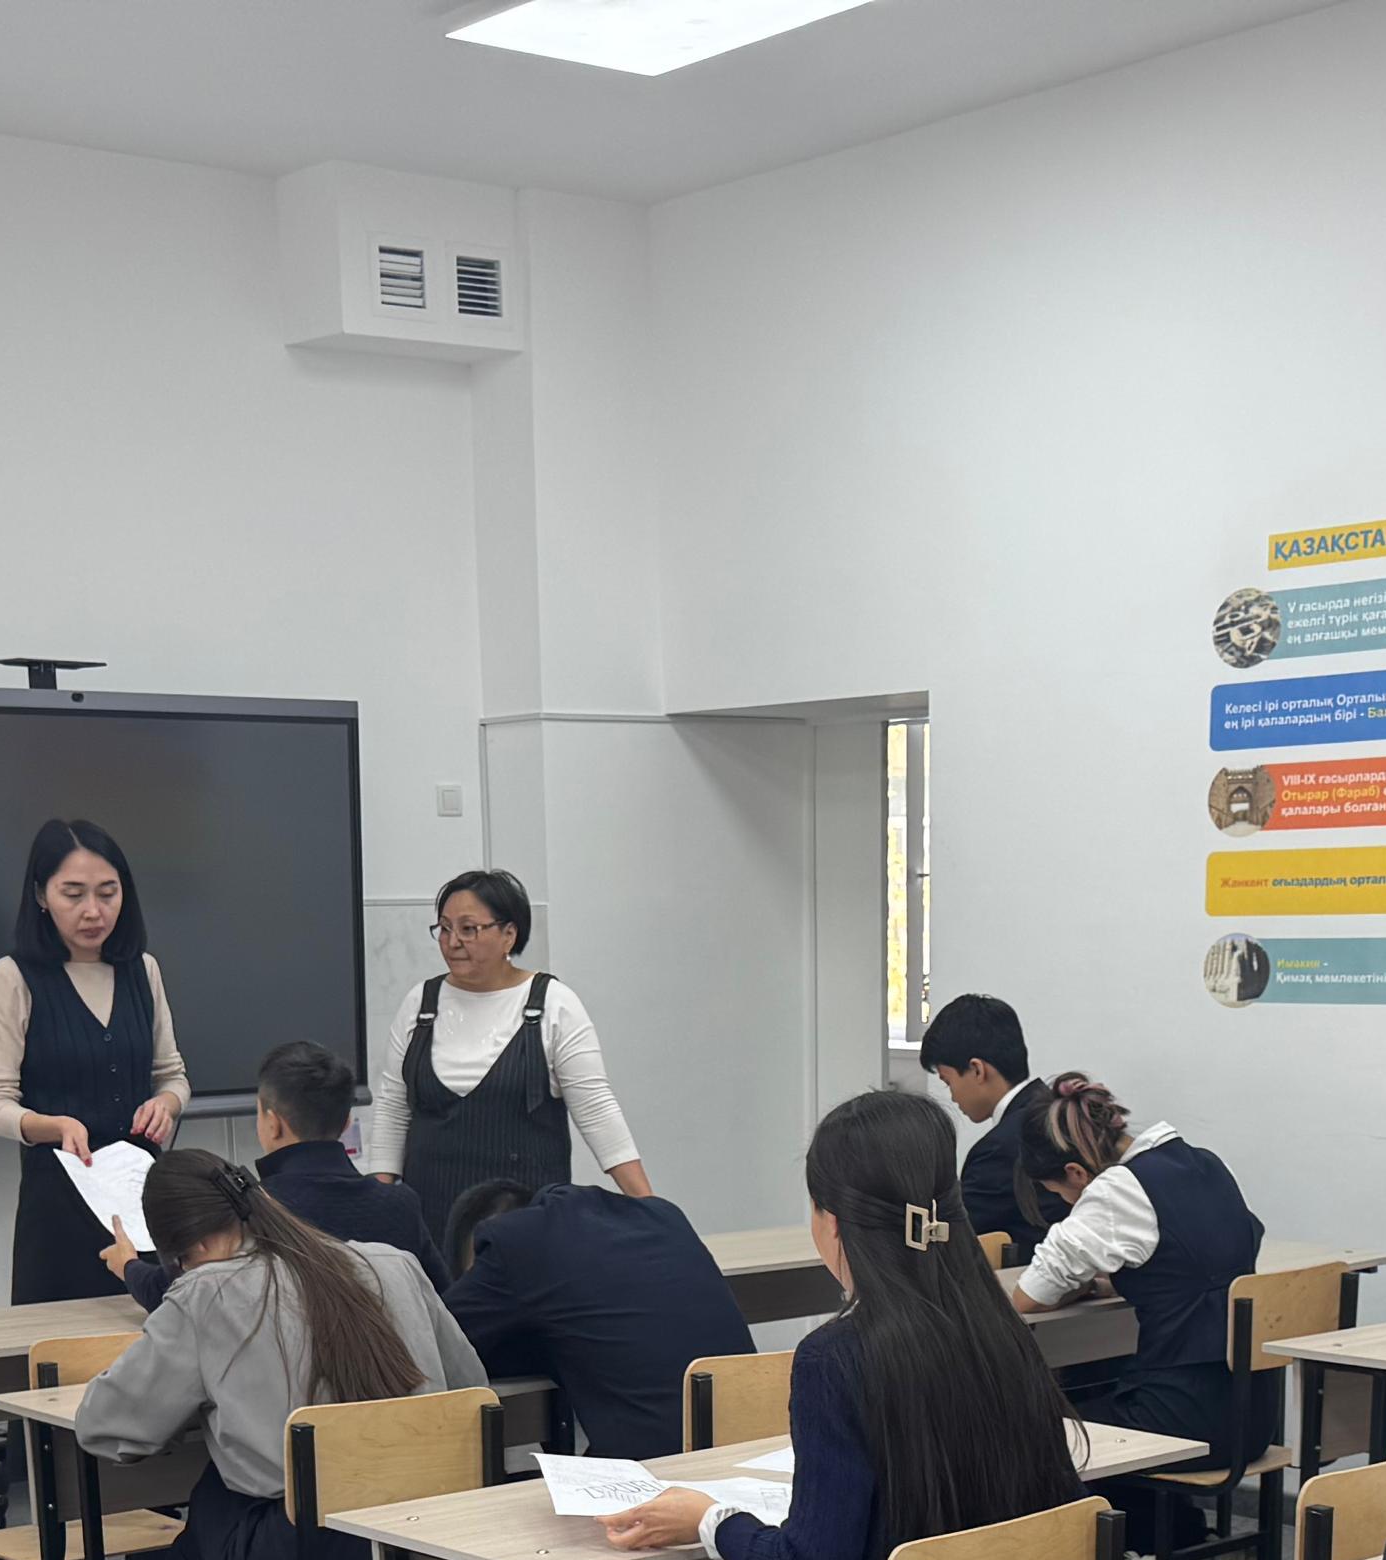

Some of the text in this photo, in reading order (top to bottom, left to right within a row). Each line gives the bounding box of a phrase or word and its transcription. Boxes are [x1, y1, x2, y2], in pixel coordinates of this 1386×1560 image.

[1281, 697, 1333, 712] орталық
[1281, 789, 1329, 803] Отырар
[1332, 785, 1380, 802] (Фараб)
